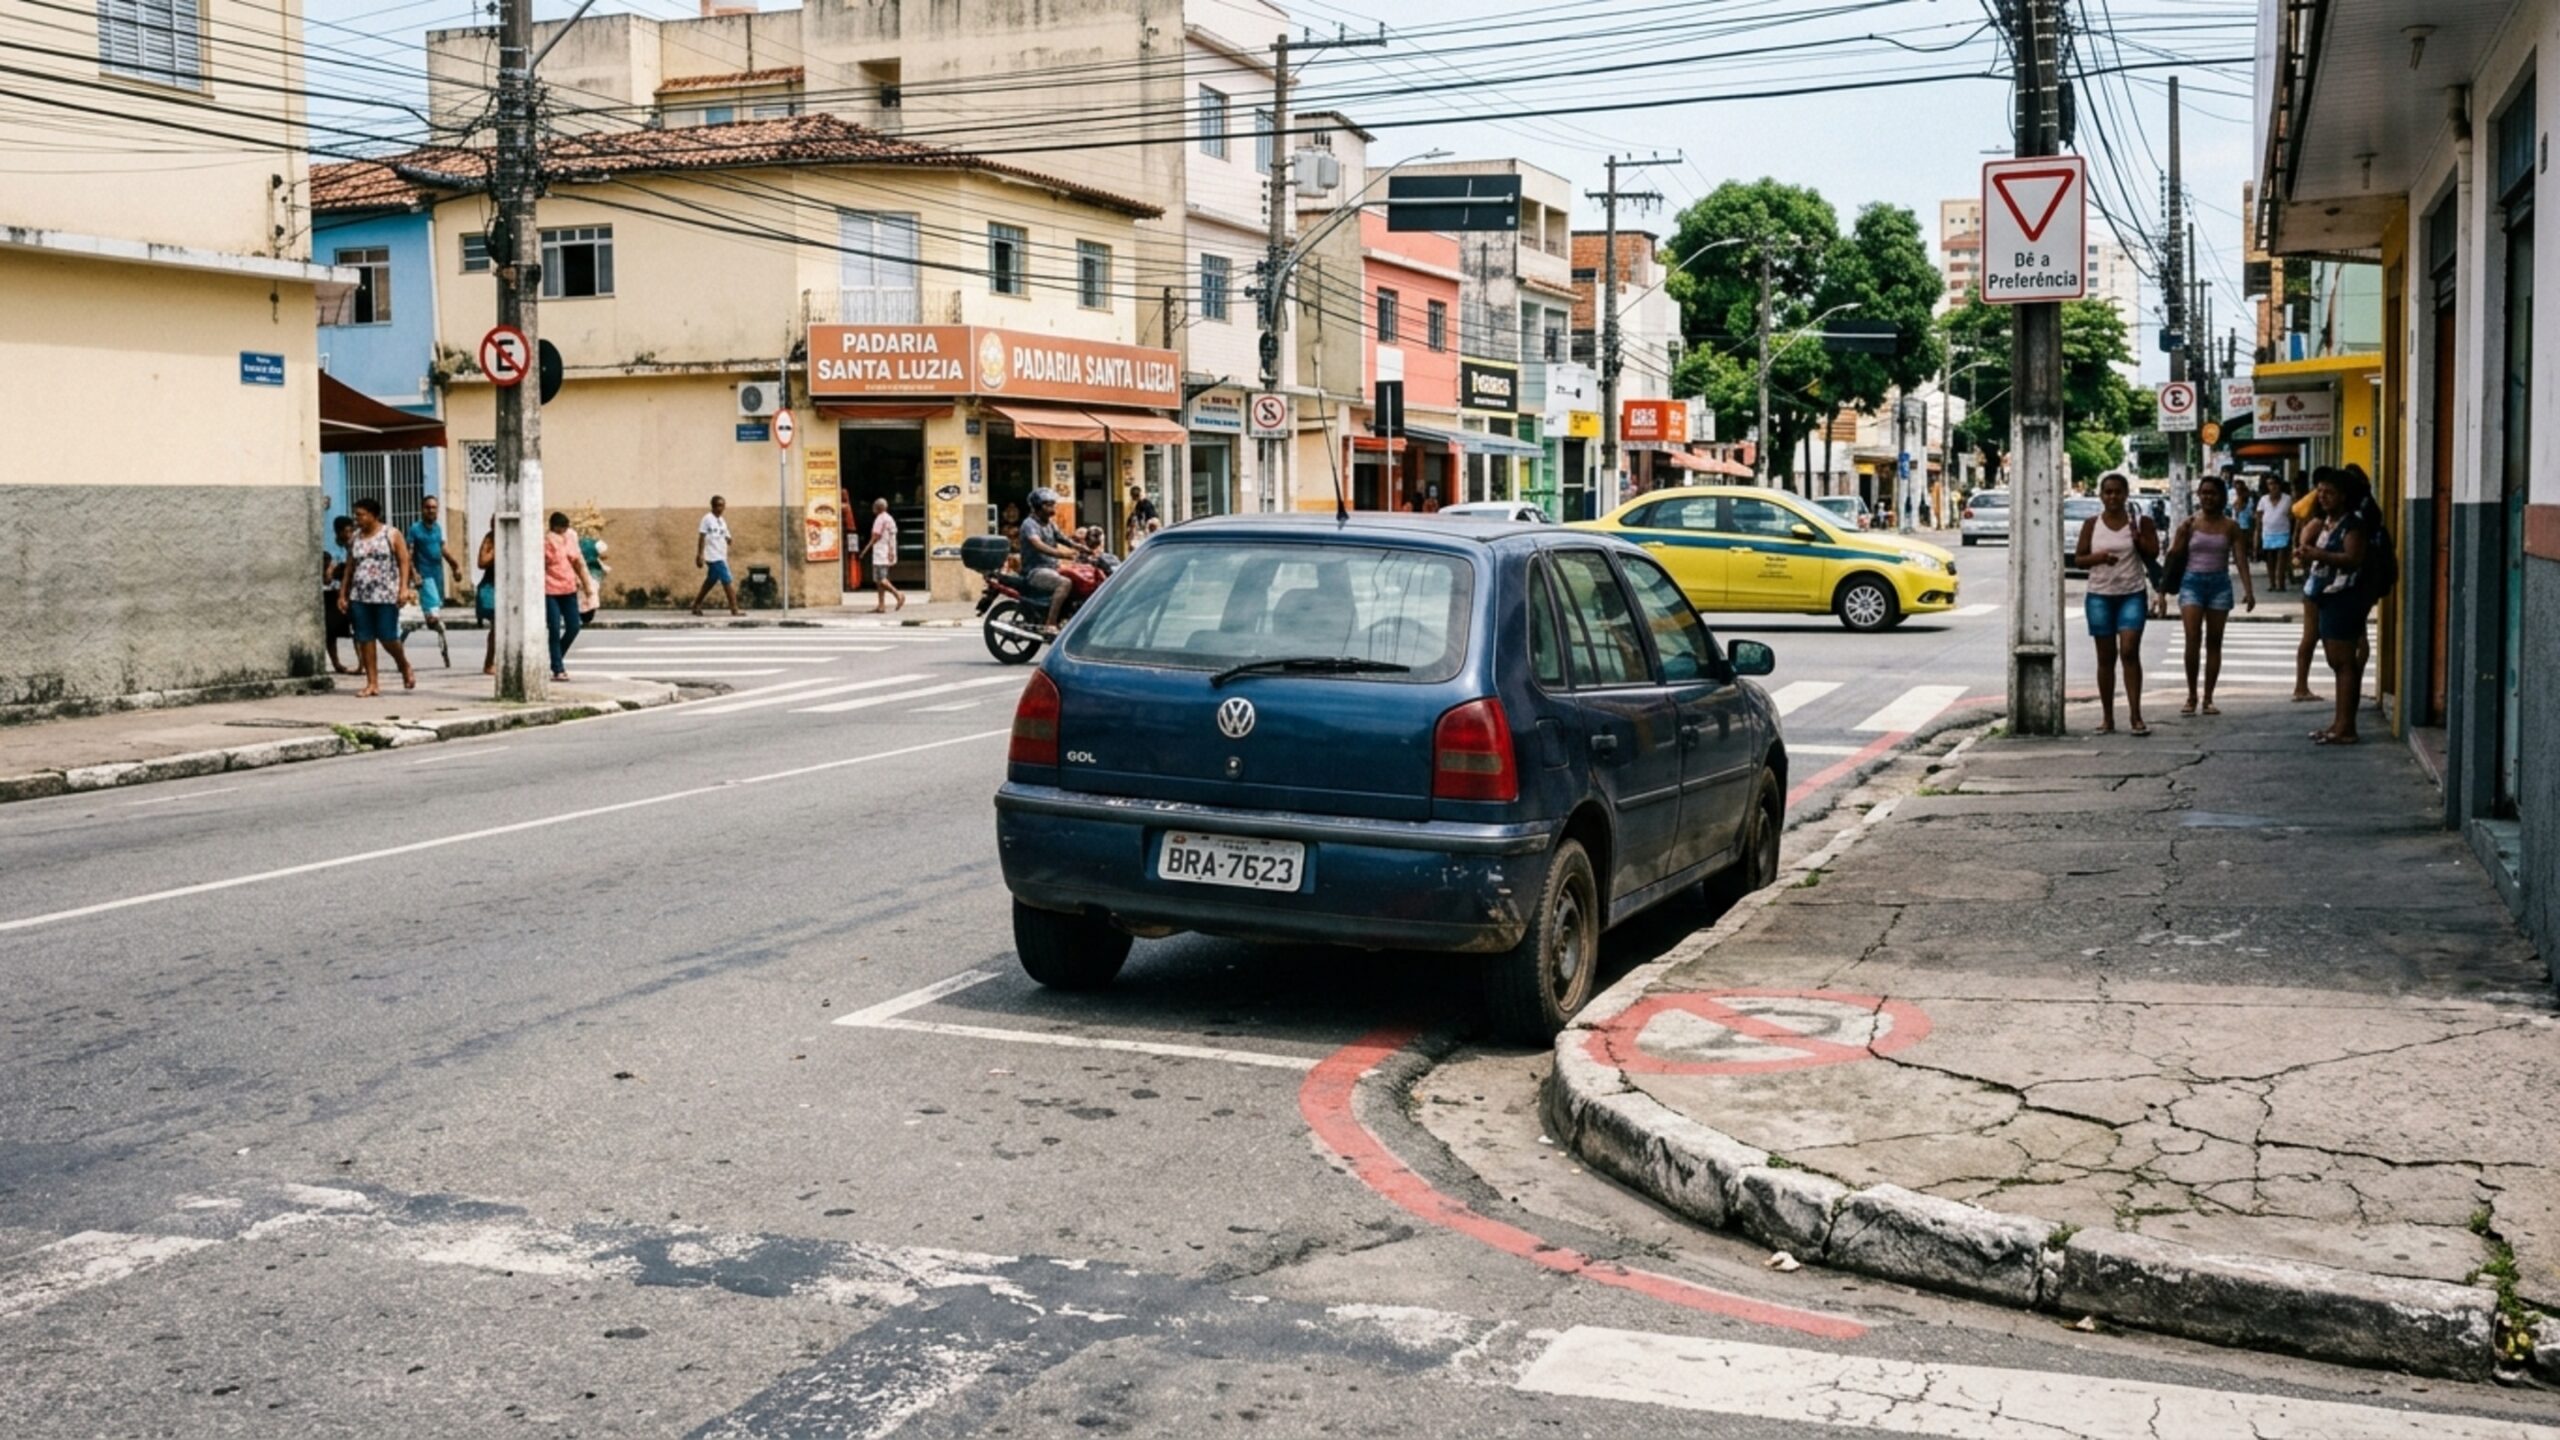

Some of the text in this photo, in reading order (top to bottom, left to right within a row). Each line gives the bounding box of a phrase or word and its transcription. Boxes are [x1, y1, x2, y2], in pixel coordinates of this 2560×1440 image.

[2041, 254, 2050, 267] a
[842, 333, 938, 353] PADARIA
[818, 359, 964, 380] SANTA LUZIA
[1013, 346, 1082, 384] PADARIA
[1085, 355, 1134, 389] SANTA
[1067, 751, 1096, 763] GOL
